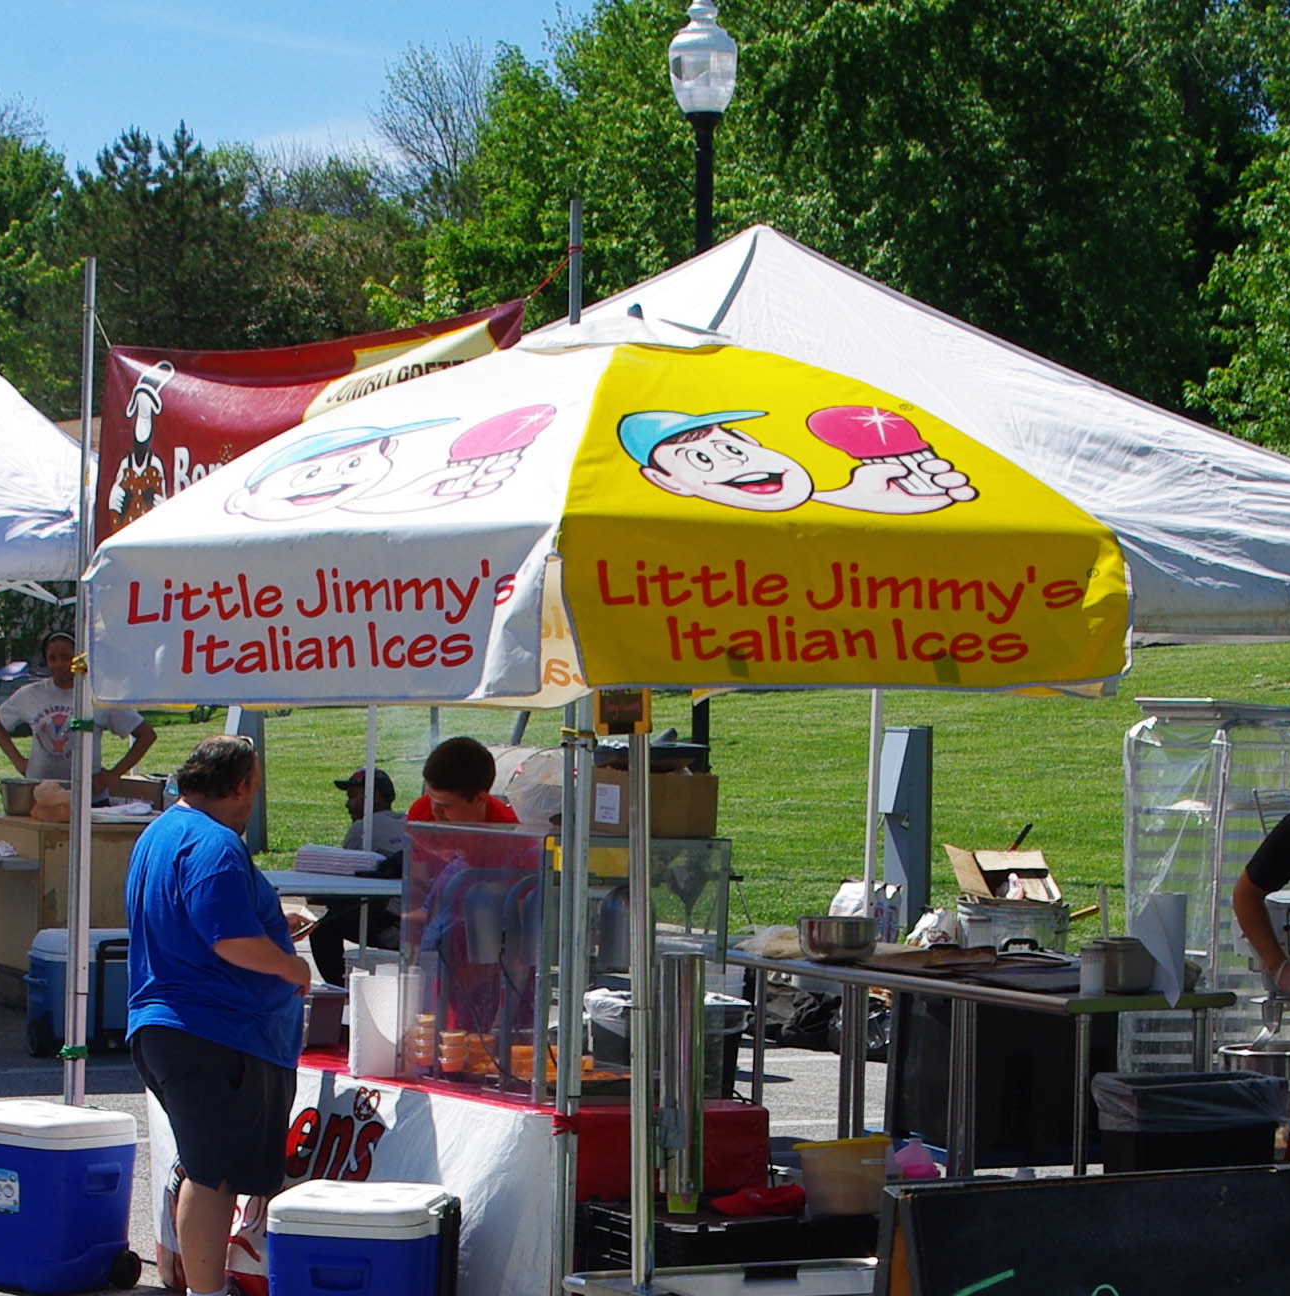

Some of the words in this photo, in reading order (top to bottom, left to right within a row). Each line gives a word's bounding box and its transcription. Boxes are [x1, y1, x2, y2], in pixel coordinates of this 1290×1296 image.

[127, 573, 285, 625] Little
[296, 559, 517, 625] Jimmy's
[596, 558, 791, 610] Little
[805, 561, 1087, 627] Jimmy's
[181, 626, 357, 675] Italian
[368, 622, 474, 669] Ices
[665, 613, 880, 664] Italian
[891, 616, 1031, 666] Ices
